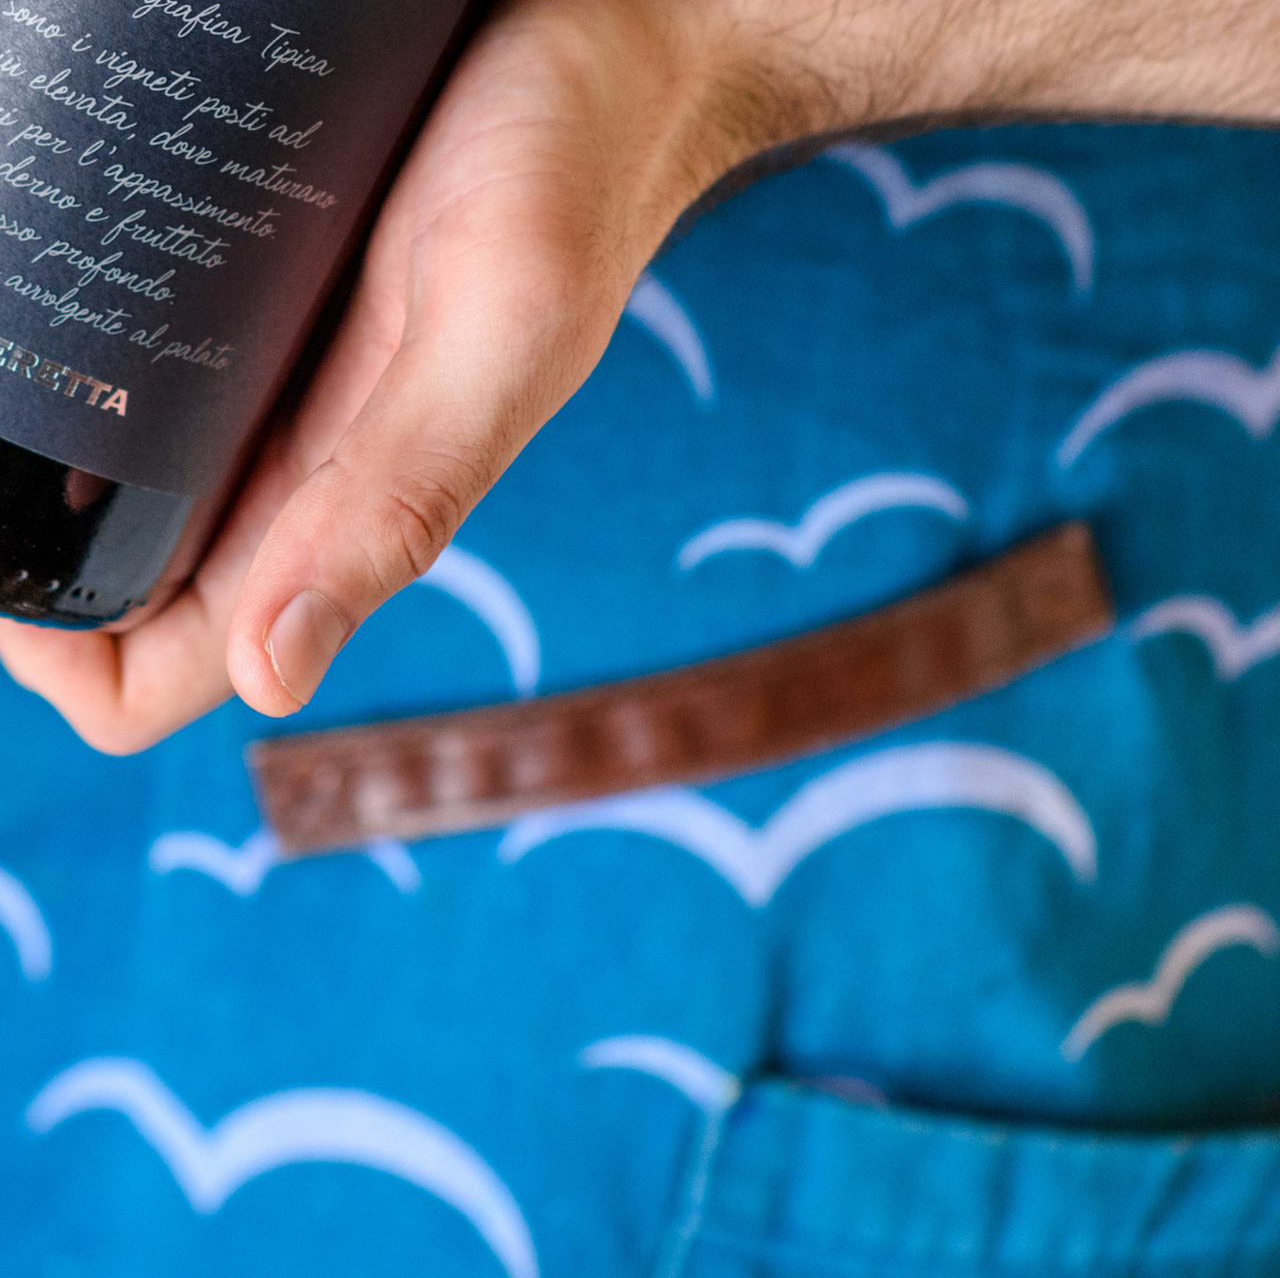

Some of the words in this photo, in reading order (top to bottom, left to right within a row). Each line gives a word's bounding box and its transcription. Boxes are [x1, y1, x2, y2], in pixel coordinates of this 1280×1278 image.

[2, 1, 65, 37] sono
[71, 33, 91, 51] i
[95, 50, 200, 99] vigneti
[182, 97, 273, 130] posti
[268, 120, 322, 146] ad
[261, 23, 333, 75] Tipica
[7, 124, 71, 153] per
[29, 68, 136, 139] elevata,
[149, 123, 217, 164] dove
[220, 163, 336, 206] maturano
[85, 207, 109, 221] e
[100, 209, 230, 267] fruttato
[31, 240, 175, 300] profondo.
[129, 324, 166, 347] al
